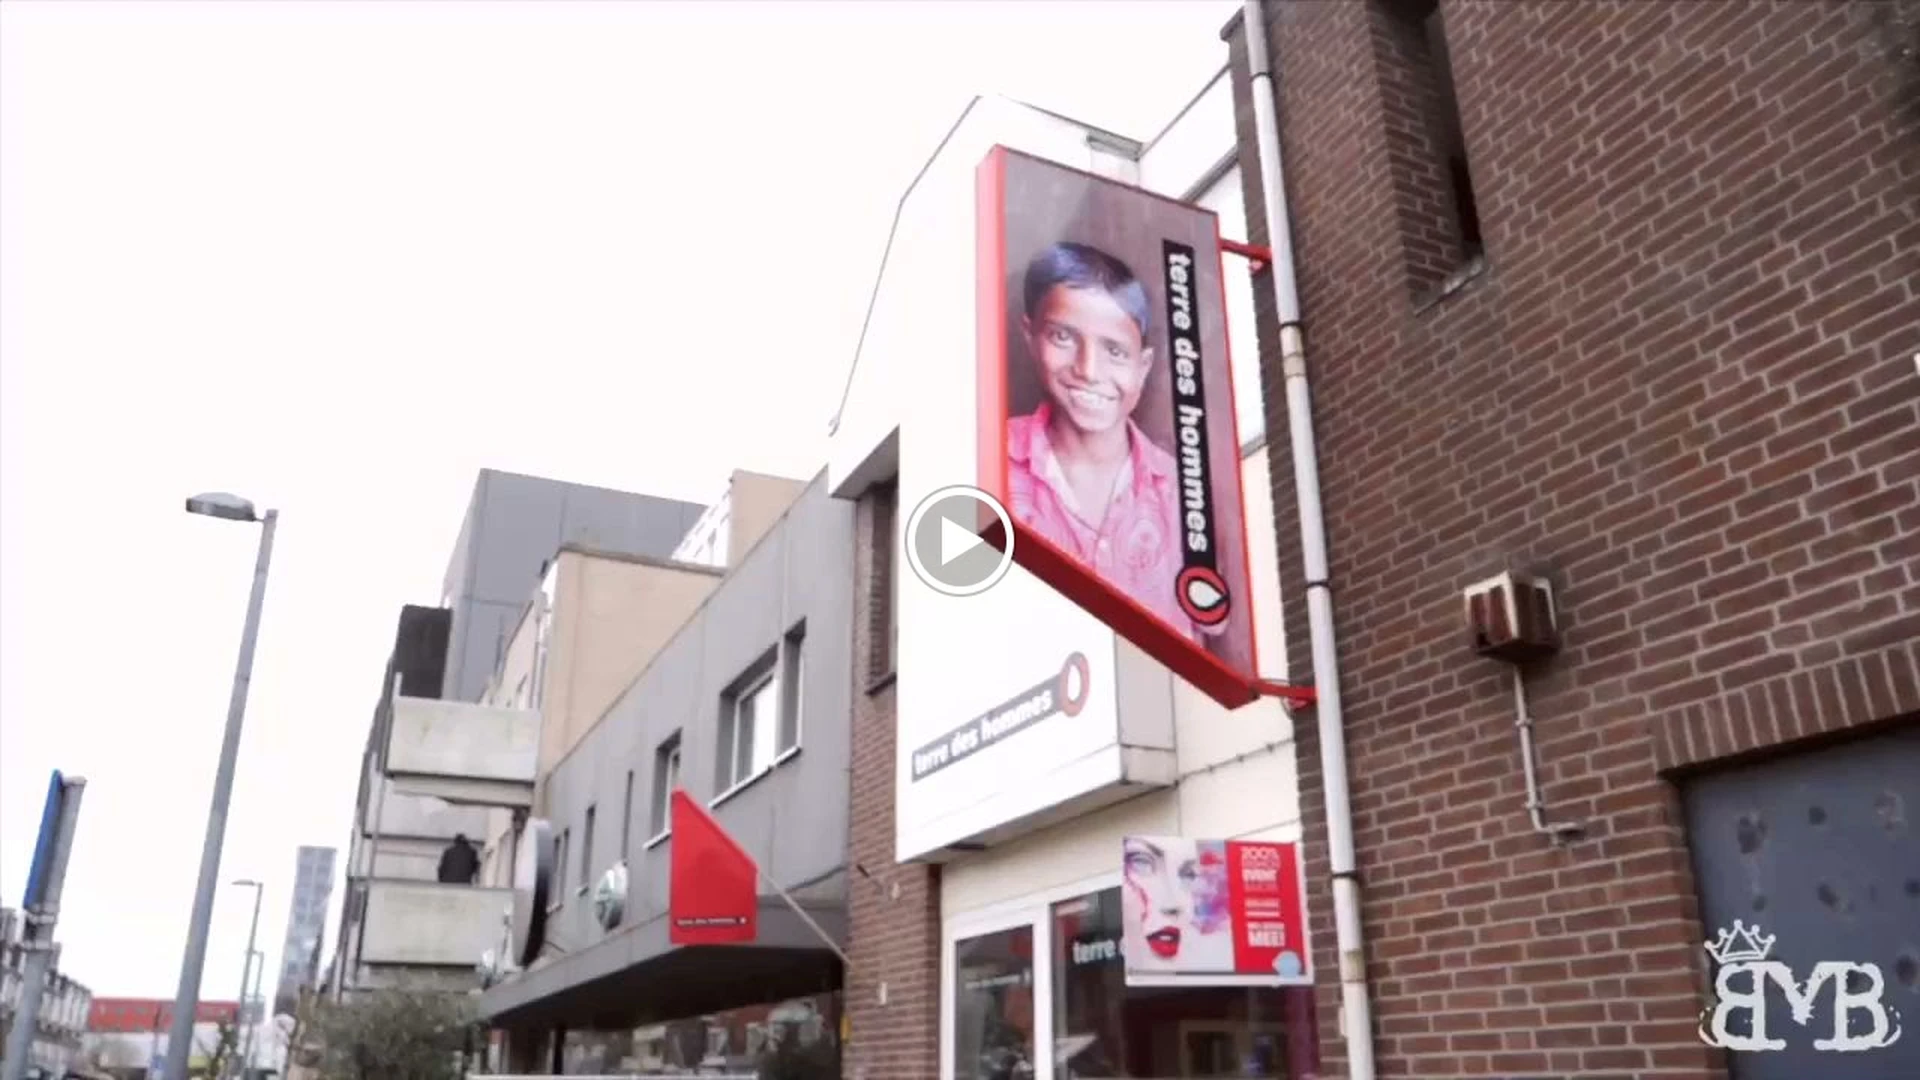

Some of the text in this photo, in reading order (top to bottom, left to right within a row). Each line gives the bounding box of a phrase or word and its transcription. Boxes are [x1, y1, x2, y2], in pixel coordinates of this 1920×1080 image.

[1168, 253, 1208, 552] terre des hommes
[915, 689, 1053, 775] terre des hommes
[1073, 939, 1117, 965] terre
